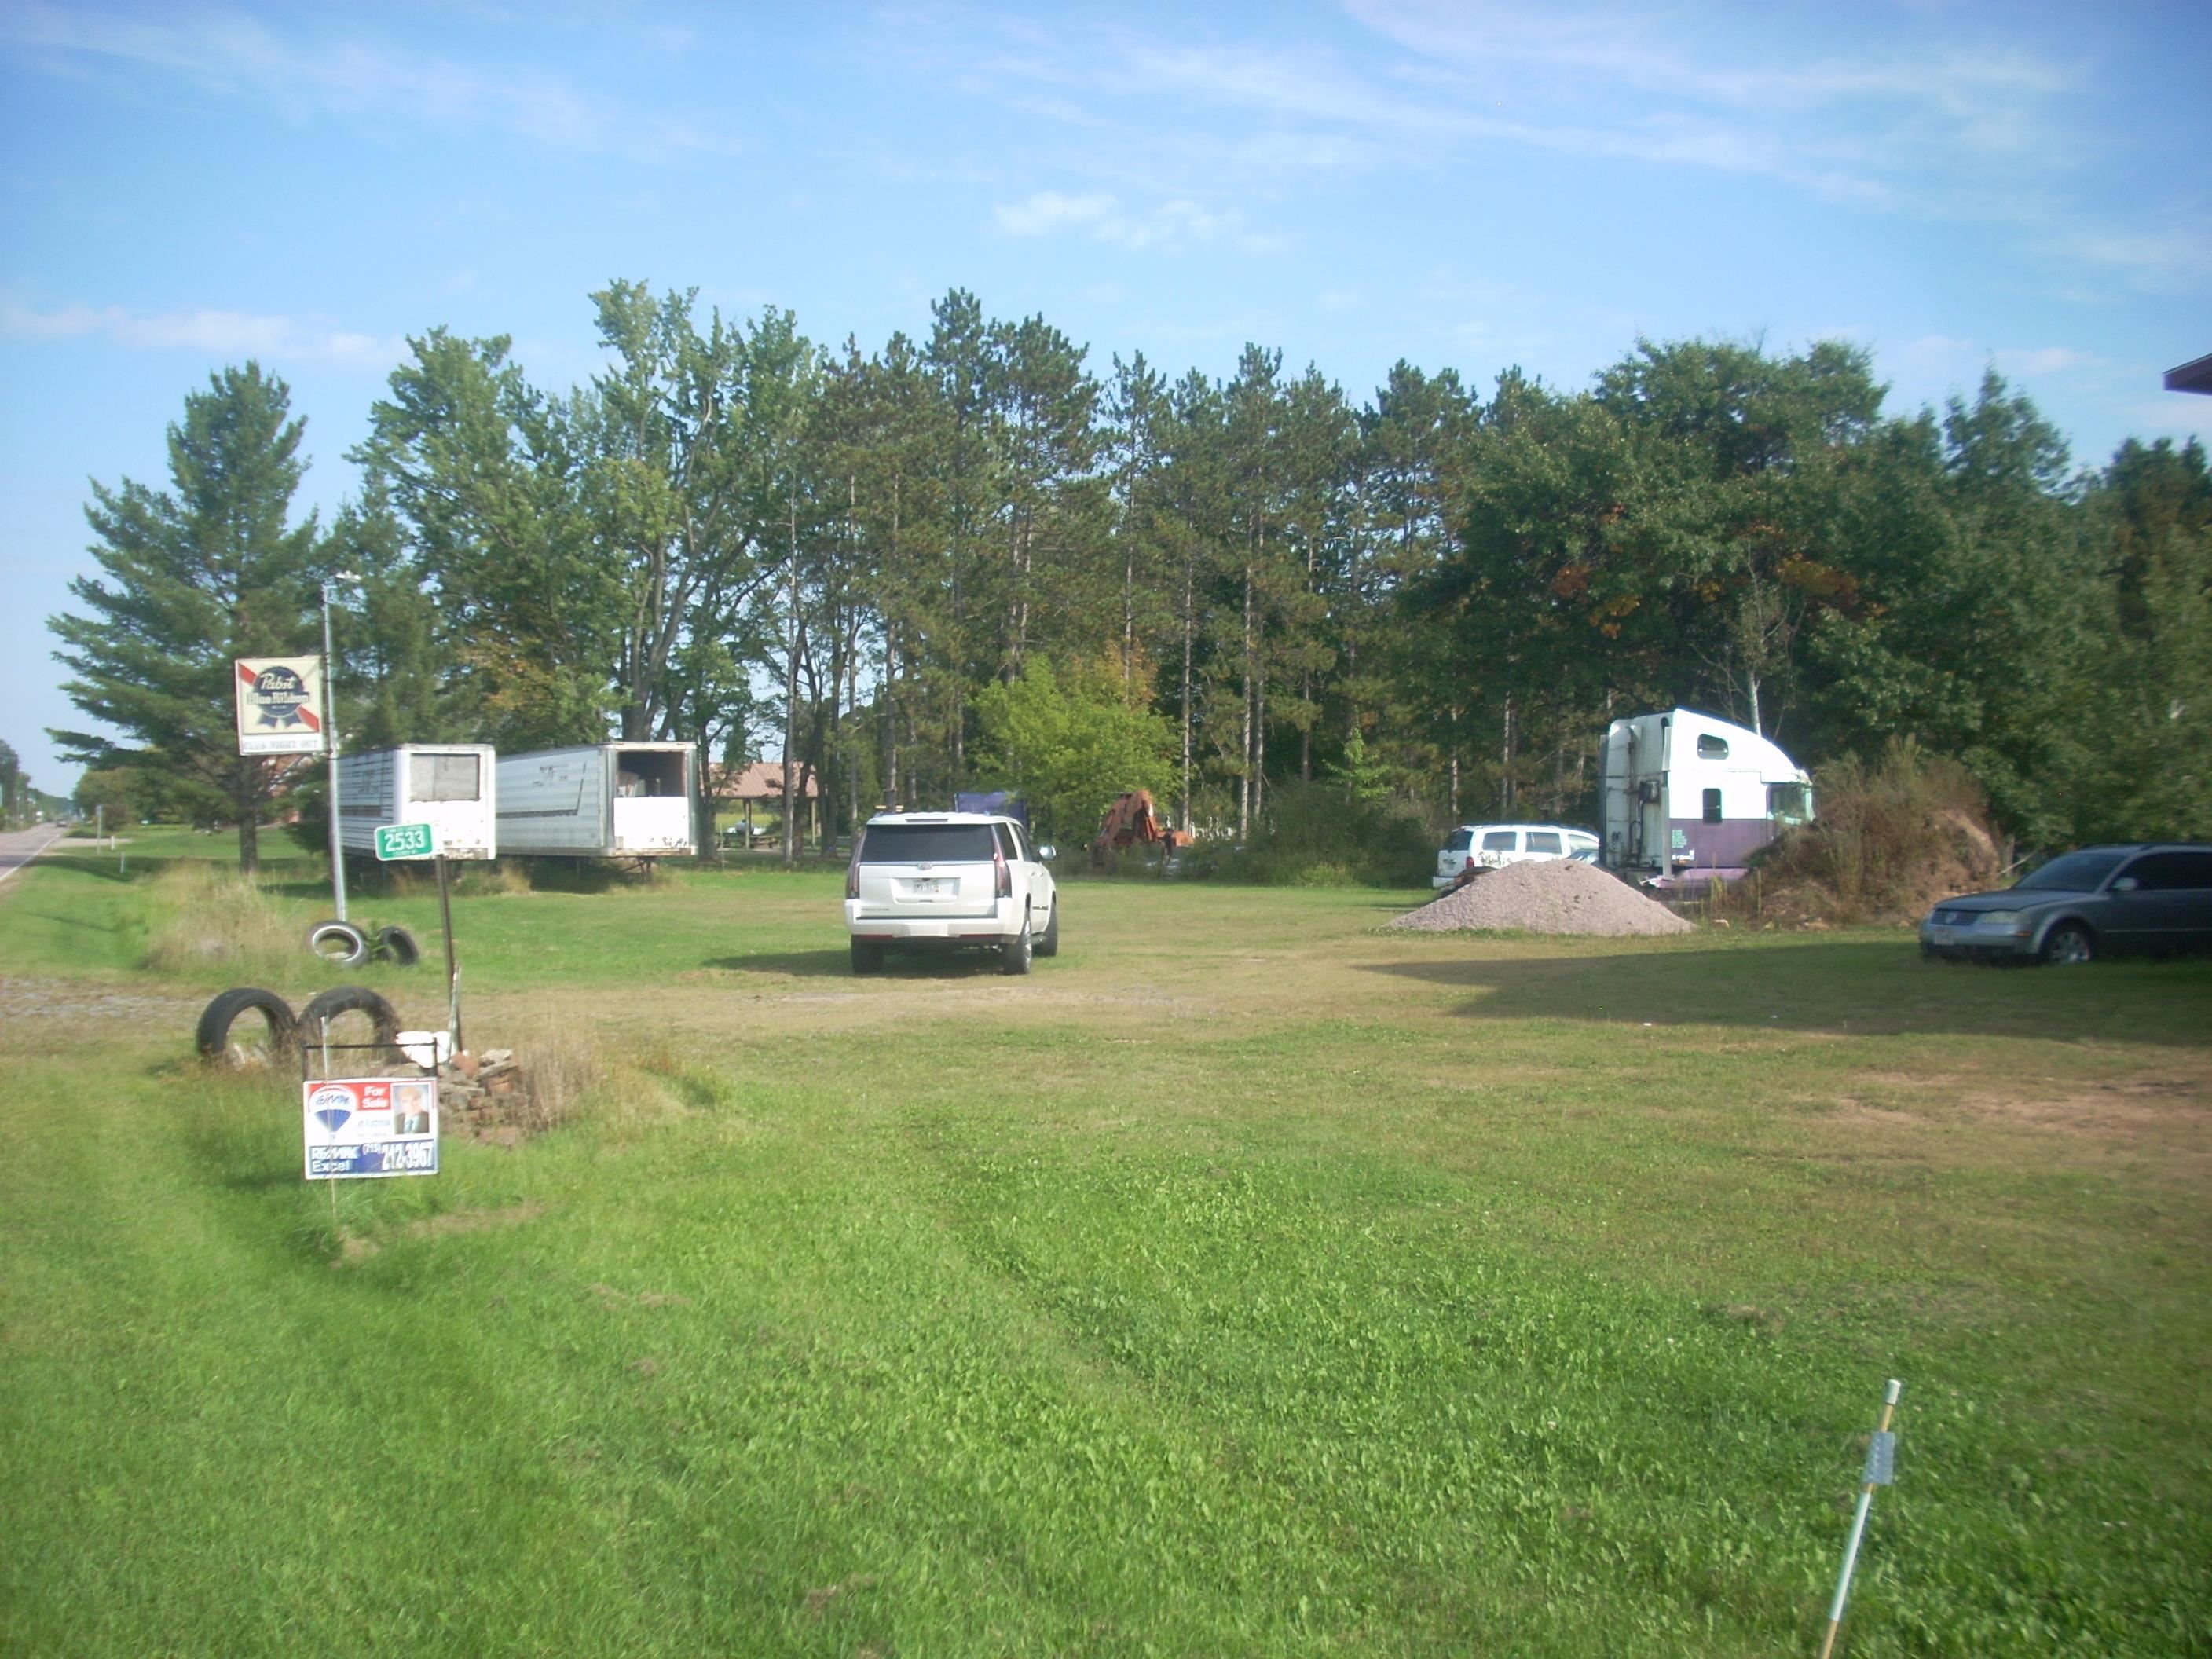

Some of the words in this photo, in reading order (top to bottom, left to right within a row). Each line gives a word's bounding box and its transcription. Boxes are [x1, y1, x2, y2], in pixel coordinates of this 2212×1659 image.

[260, 673, 296, 690] Pabst
[247, 692, 271, 705] Blue
[271, 692, 309, 704] Ribbon
[300, 739, 318, 749] OUT
[384, 830, 425, 852] 2533
[364, 1086, 386, 1097] For
[361, 1097, 389, 1108] Sale
[382, 1141, 433, 1170] 212-3967
[313, 1159, 350, 1172] Excel
